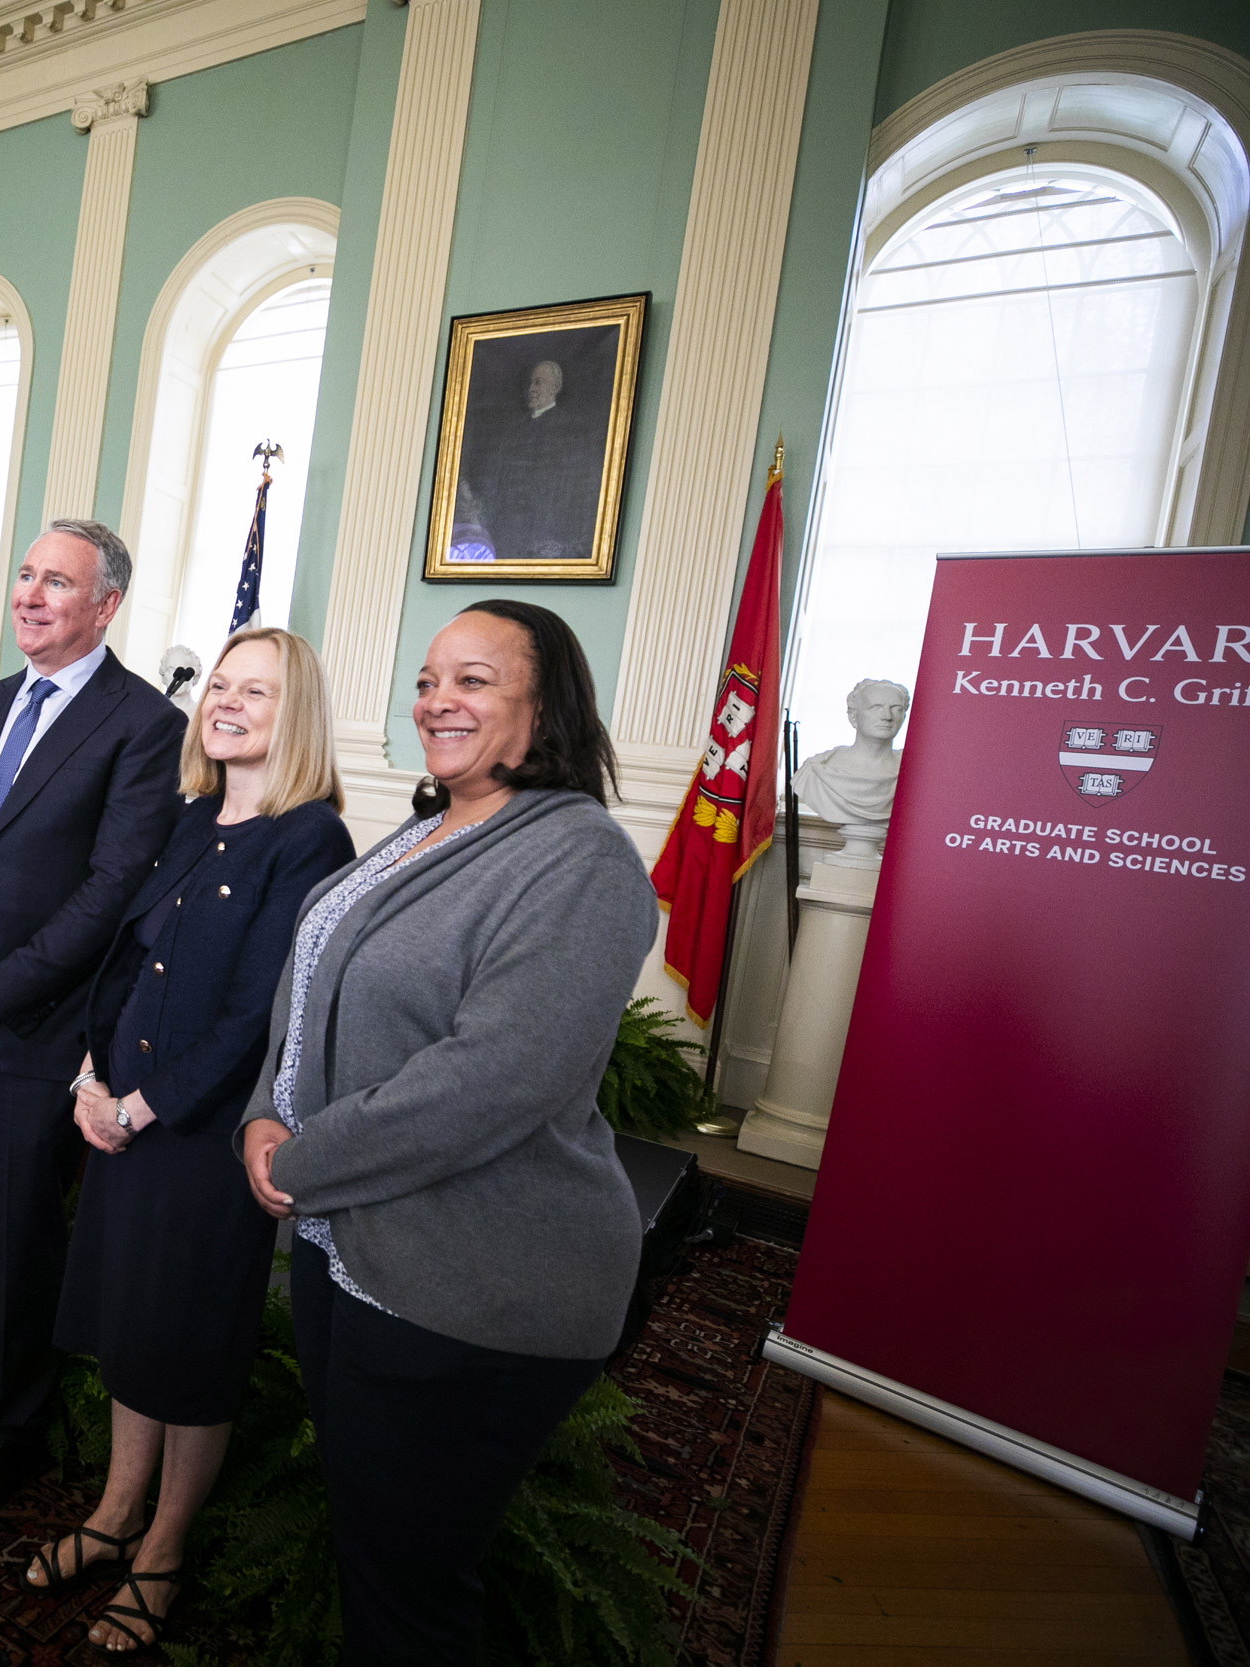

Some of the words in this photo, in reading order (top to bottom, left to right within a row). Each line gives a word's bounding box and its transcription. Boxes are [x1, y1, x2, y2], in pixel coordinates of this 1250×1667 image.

[952, 670, 1103, 700] Kenneth
[1119, 676, 1156, 703] C.
[1076, 731, 1096, 742] VE
[1123, 733, 1142, 744] RI
[1090, 777, 1113, 789] TAS
[969, 814, 1098, 842] GRADUATE
[1104, 828, 1217, 855] SCHOOL
[944, 832, 976, 849] OF
[978, 837, 1041, 858] ARTS
[1046, 845, 1101, 865] AND
[1107, 852, 1247, 882] SCIENCES
